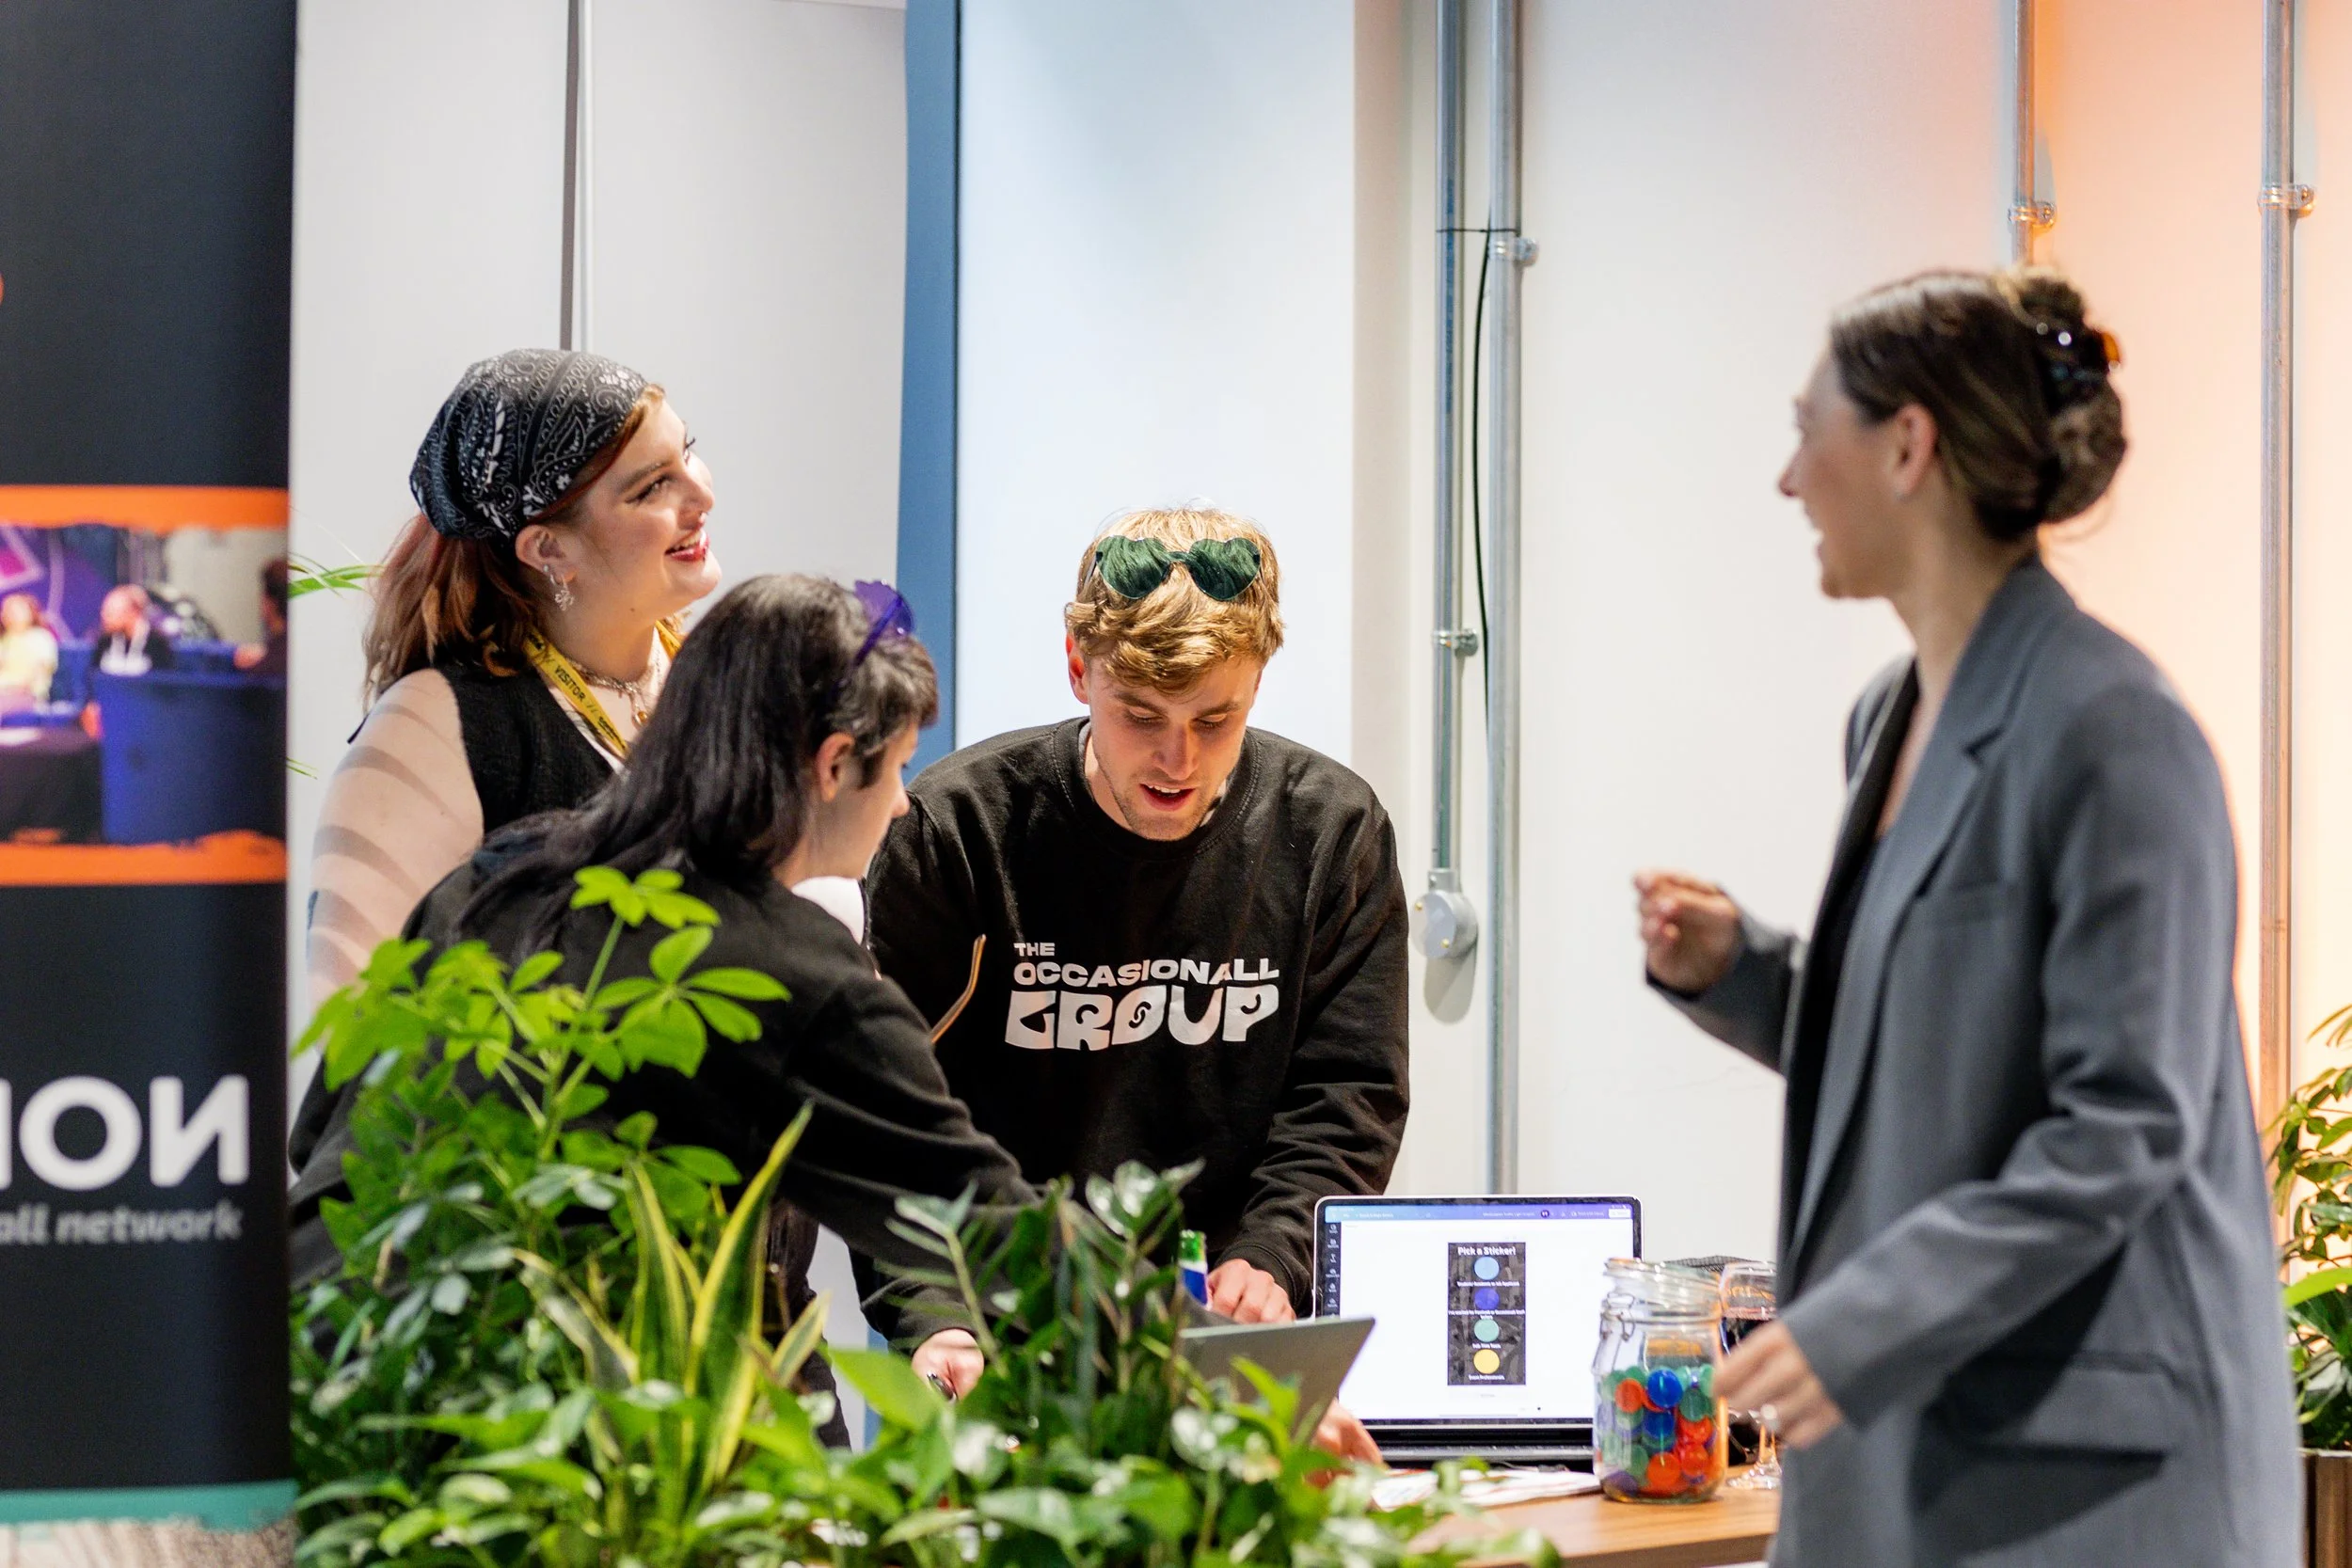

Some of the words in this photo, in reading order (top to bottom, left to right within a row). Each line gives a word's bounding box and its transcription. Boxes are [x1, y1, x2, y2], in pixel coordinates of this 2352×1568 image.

[554, 665, 586, 703] VISITOR
[1013, 942, 1055, 957] THE
[1013, 958, 1279, 988] OCCASIONALL
[1005, 983, 1279, 1052] GROUP
[55, 1199, 243, 1243] network
[1457, 1246, 1476, 1256] Pick
[1483, 1246, 1517, 1256] Sticker!
